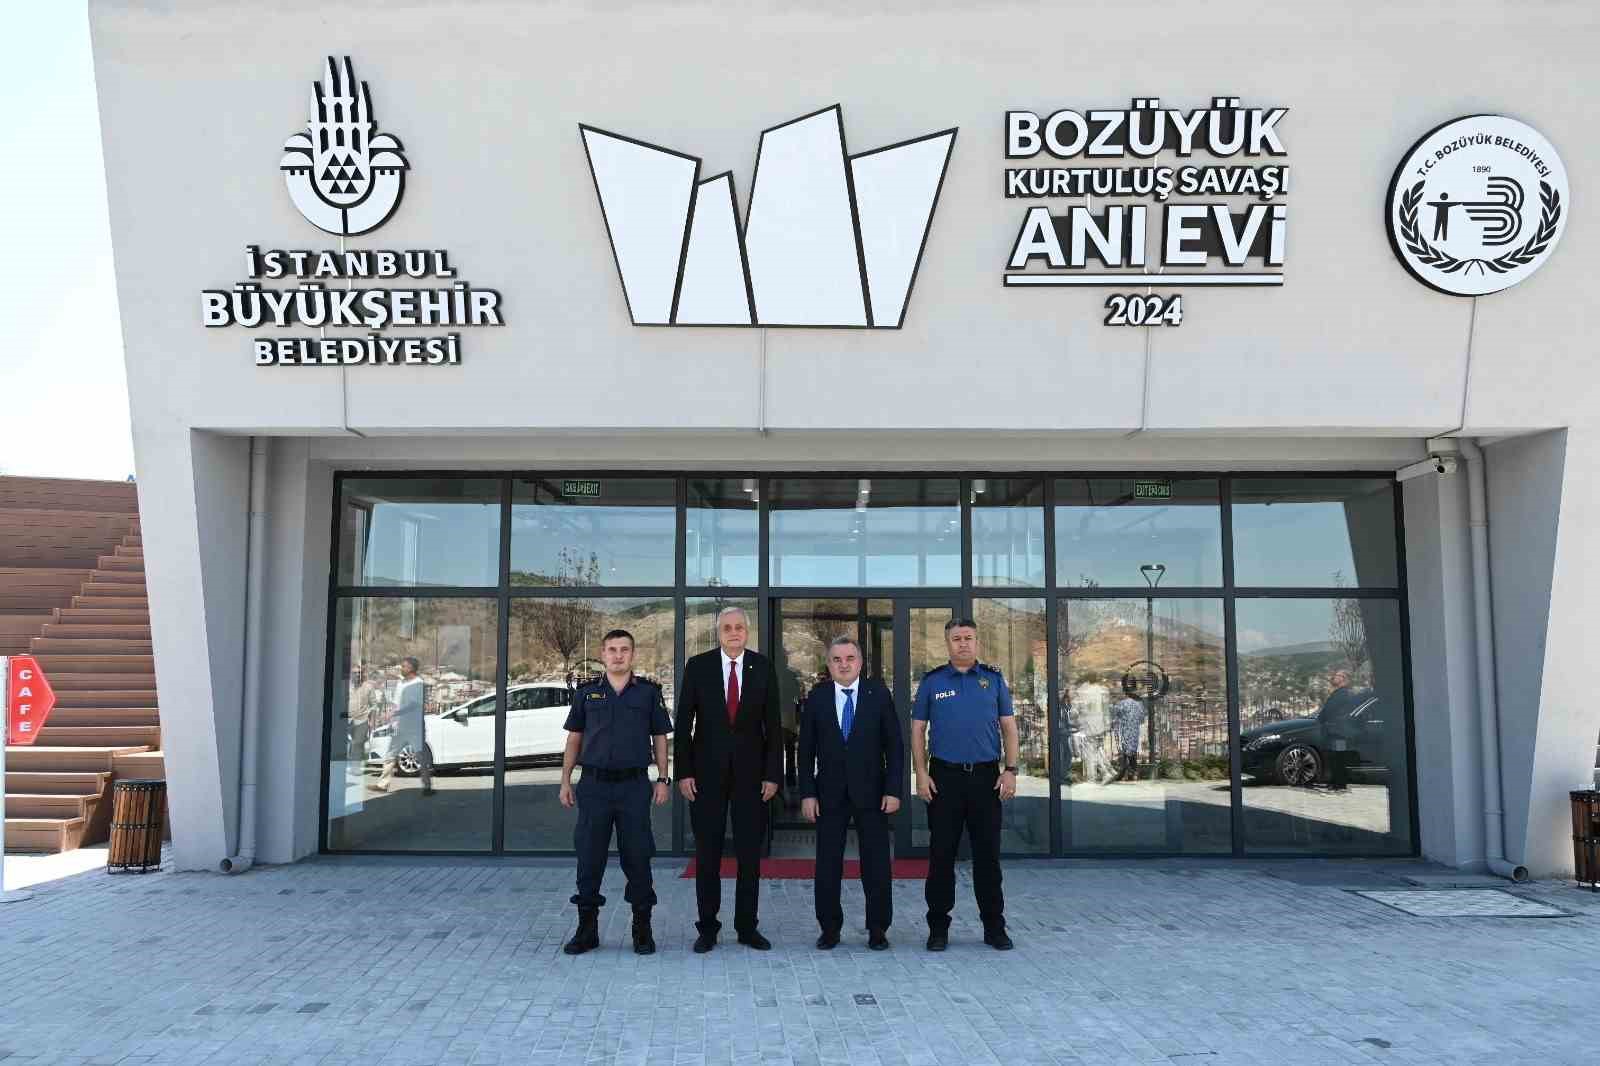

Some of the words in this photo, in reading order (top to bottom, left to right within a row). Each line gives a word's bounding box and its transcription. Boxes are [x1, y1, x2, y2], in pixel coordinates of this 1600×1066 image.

[1005, 97, 1289, 159] BOZÜYÜK
[1417, 159, 1437, 177] T.C.
[1435, 133, 1492, 160] BOZÜYÜK
[1495, 136, 1552, 178] BELEDİYESİ
[1005, 167, 1174, 202] KURTULUŞ
[1176, 166, 1289, 201] SAVAŞI
[1005, 205, 1148, 270] ANI
[247, 246, 457, 278] İSTANBUL
[201, 282, 505, 329] BÜYÜKŞEHİR
[1104, 294, 1183, 326] 2024
[255, 333, 461, 366] BELEDİYESİ
[19, 669, 33, 732] CAFE
